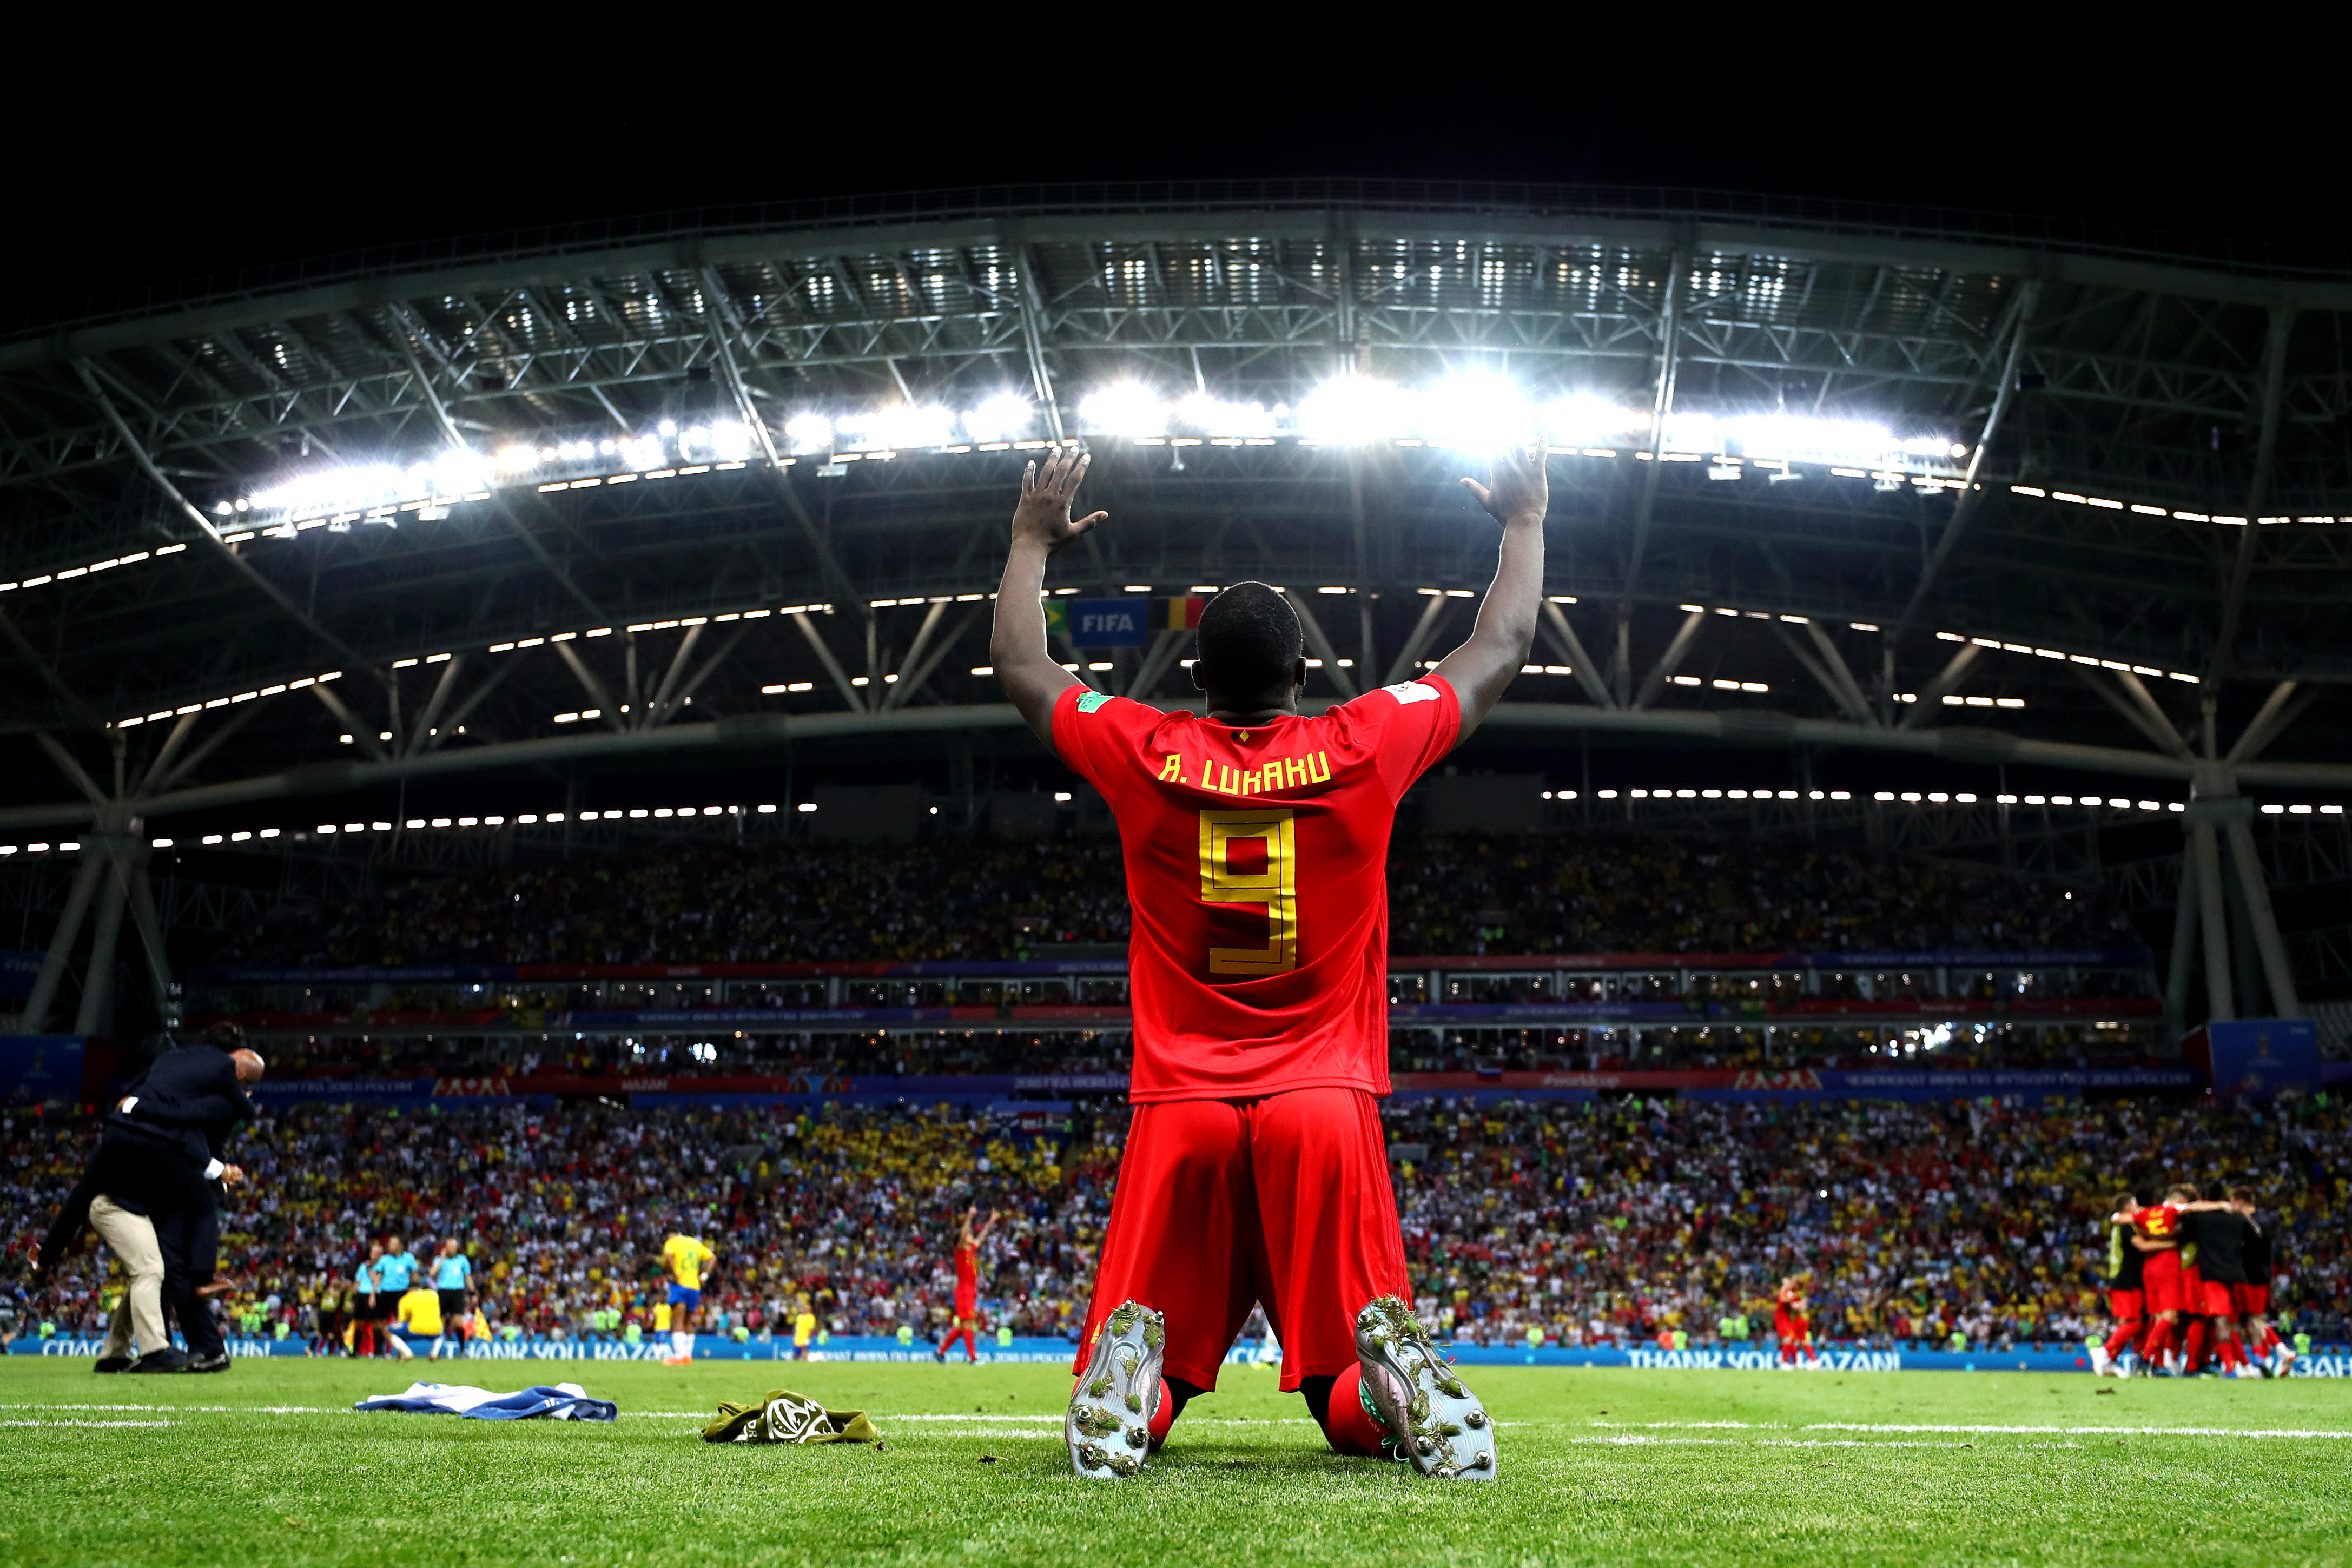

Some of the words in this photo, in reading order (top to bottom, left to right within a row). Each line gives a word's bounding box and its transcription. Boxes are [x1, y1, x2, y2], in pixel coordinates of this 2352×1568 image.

[1082, 613, 1134, 633] FIFA
[1158, 753, 1187, 783] R.
[1201, 750, 1331, 796] LUKAKU
[1199, 809, 1297, 975] 9
[1627, 1351, 1722, 1369] THANK
